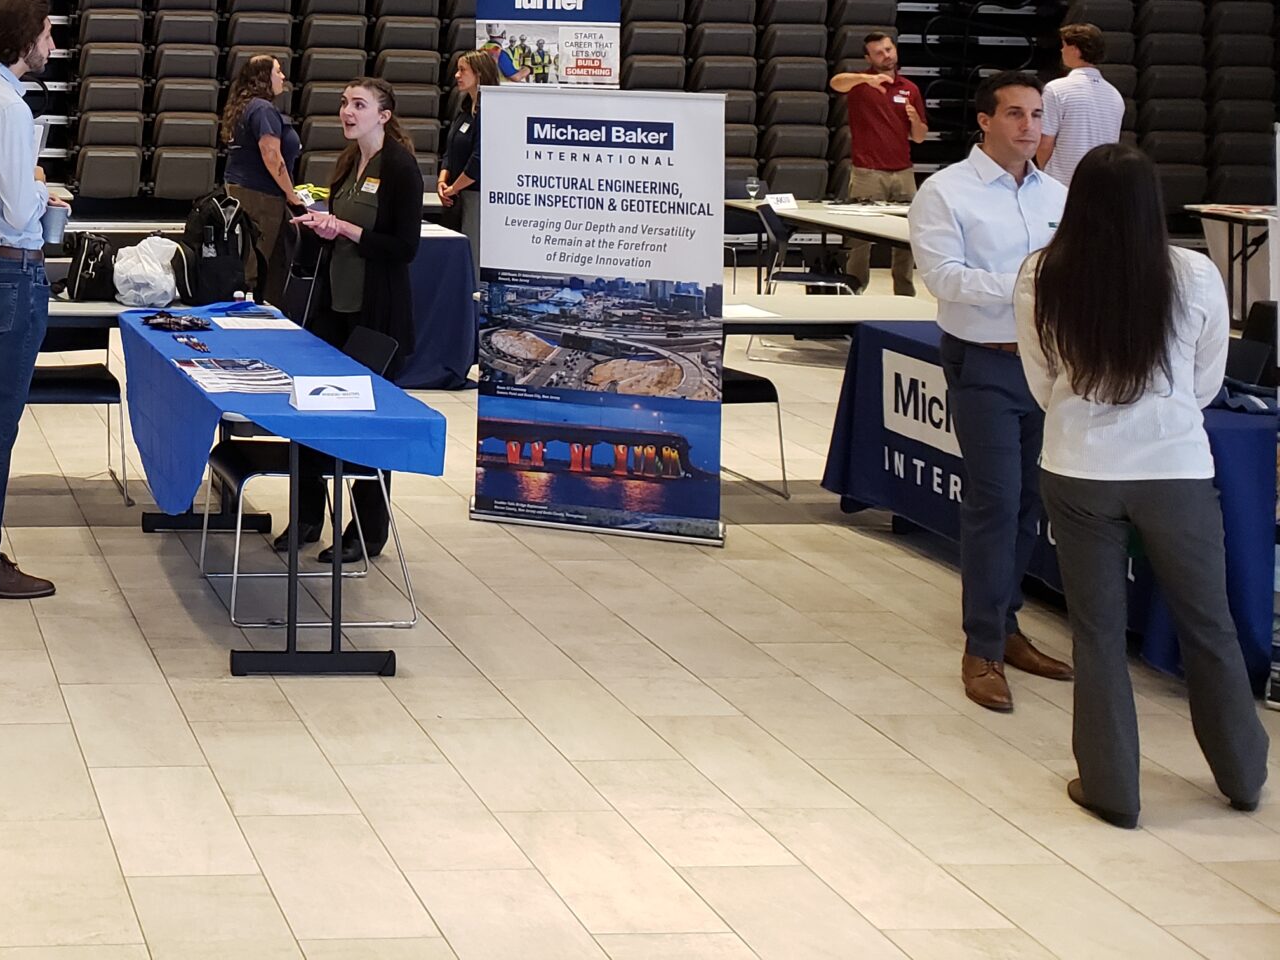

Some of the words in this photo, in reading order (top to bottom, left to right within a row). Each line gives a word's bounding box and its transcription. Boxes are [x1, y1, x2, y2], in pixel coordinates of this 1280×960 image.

[566, 68, 611, 76] SOMETHING
[533, 123, 606, 142] Michael
[611, 127, 668, 145] Baker
[526, 150, 674, 166] INTERNATIONAL
[516, 174, 594, 191] STRUCTURAL
[597, 178, 683, 199] ENGINEERING,
[488, 191, 532, 206] BRIDGE
[534, 193, 605, 211] INSPECTION
[607, 198, 618, 211] &
[620, 198, 714, 216] GEOTECHNICAL
[504, 216, 562, 232] Leveraging
[564, 219, 583, 231] Our
[584, 221, 616, 235] Depth
[618, 223, 639, 235] and
[641, 224, 696, 240] Versatility
[531, 234, 542, 244] to
[544, 235, 583, 247] Remain
[584, 238, 595, 248] at
[597, 238, 615, 249] the
[617, 239, 668, 252] Forefront
[546, 251, 557, 261] of
[558, 252, 593, 266] Bridge
[595, 254, 652, 268] Innovation
